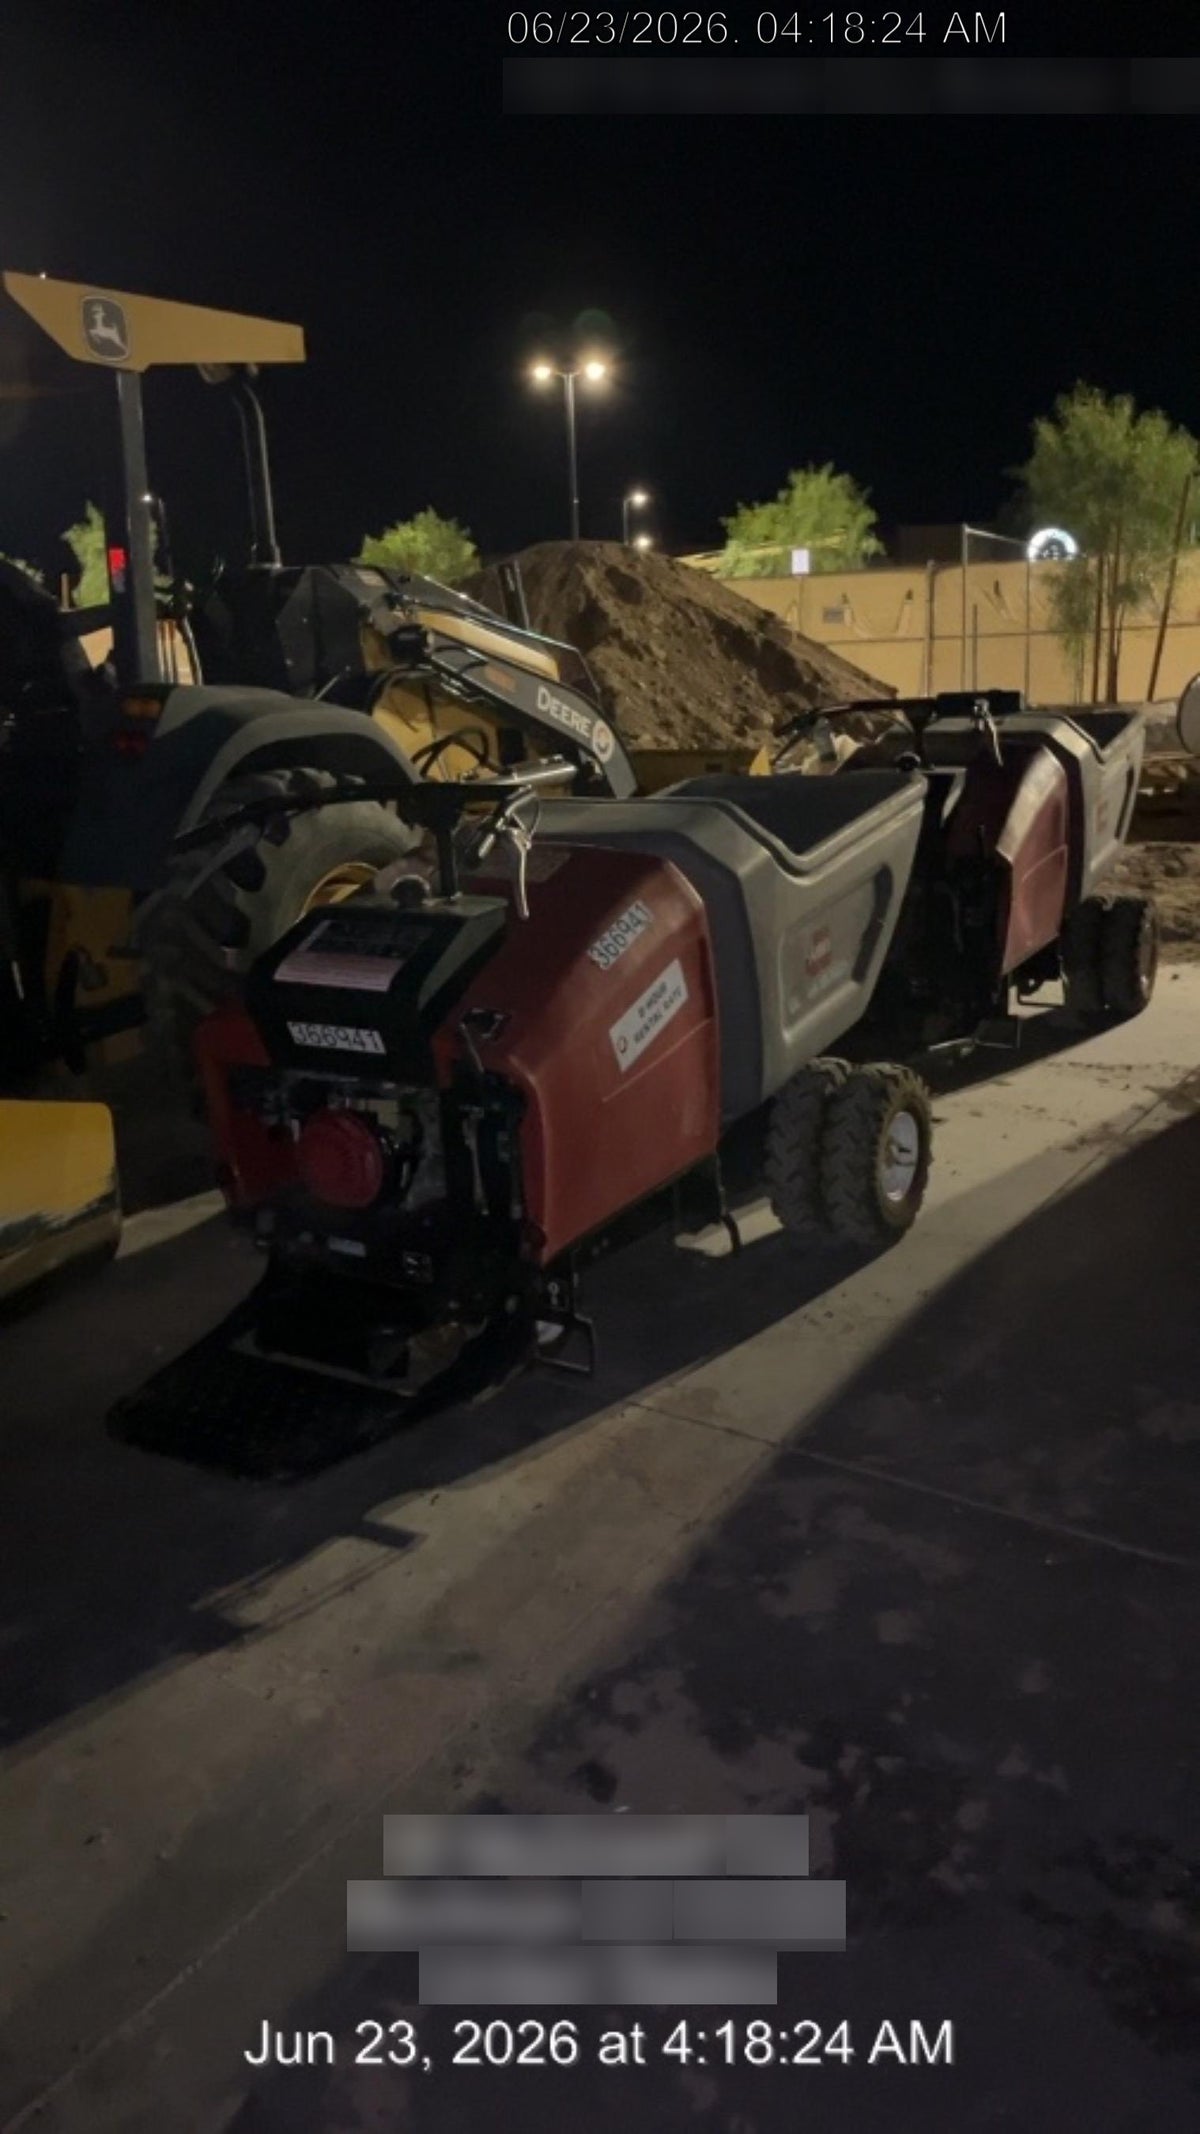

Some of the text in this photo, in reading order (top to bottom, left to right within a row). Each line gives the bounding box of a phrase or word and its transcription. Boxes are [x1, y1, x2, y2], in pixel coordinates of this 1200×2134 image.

[537, 685, 592, 738] DEERE
[589, 902, 649, 967] 366941
[290, 1021, 383, 1052] 366941
